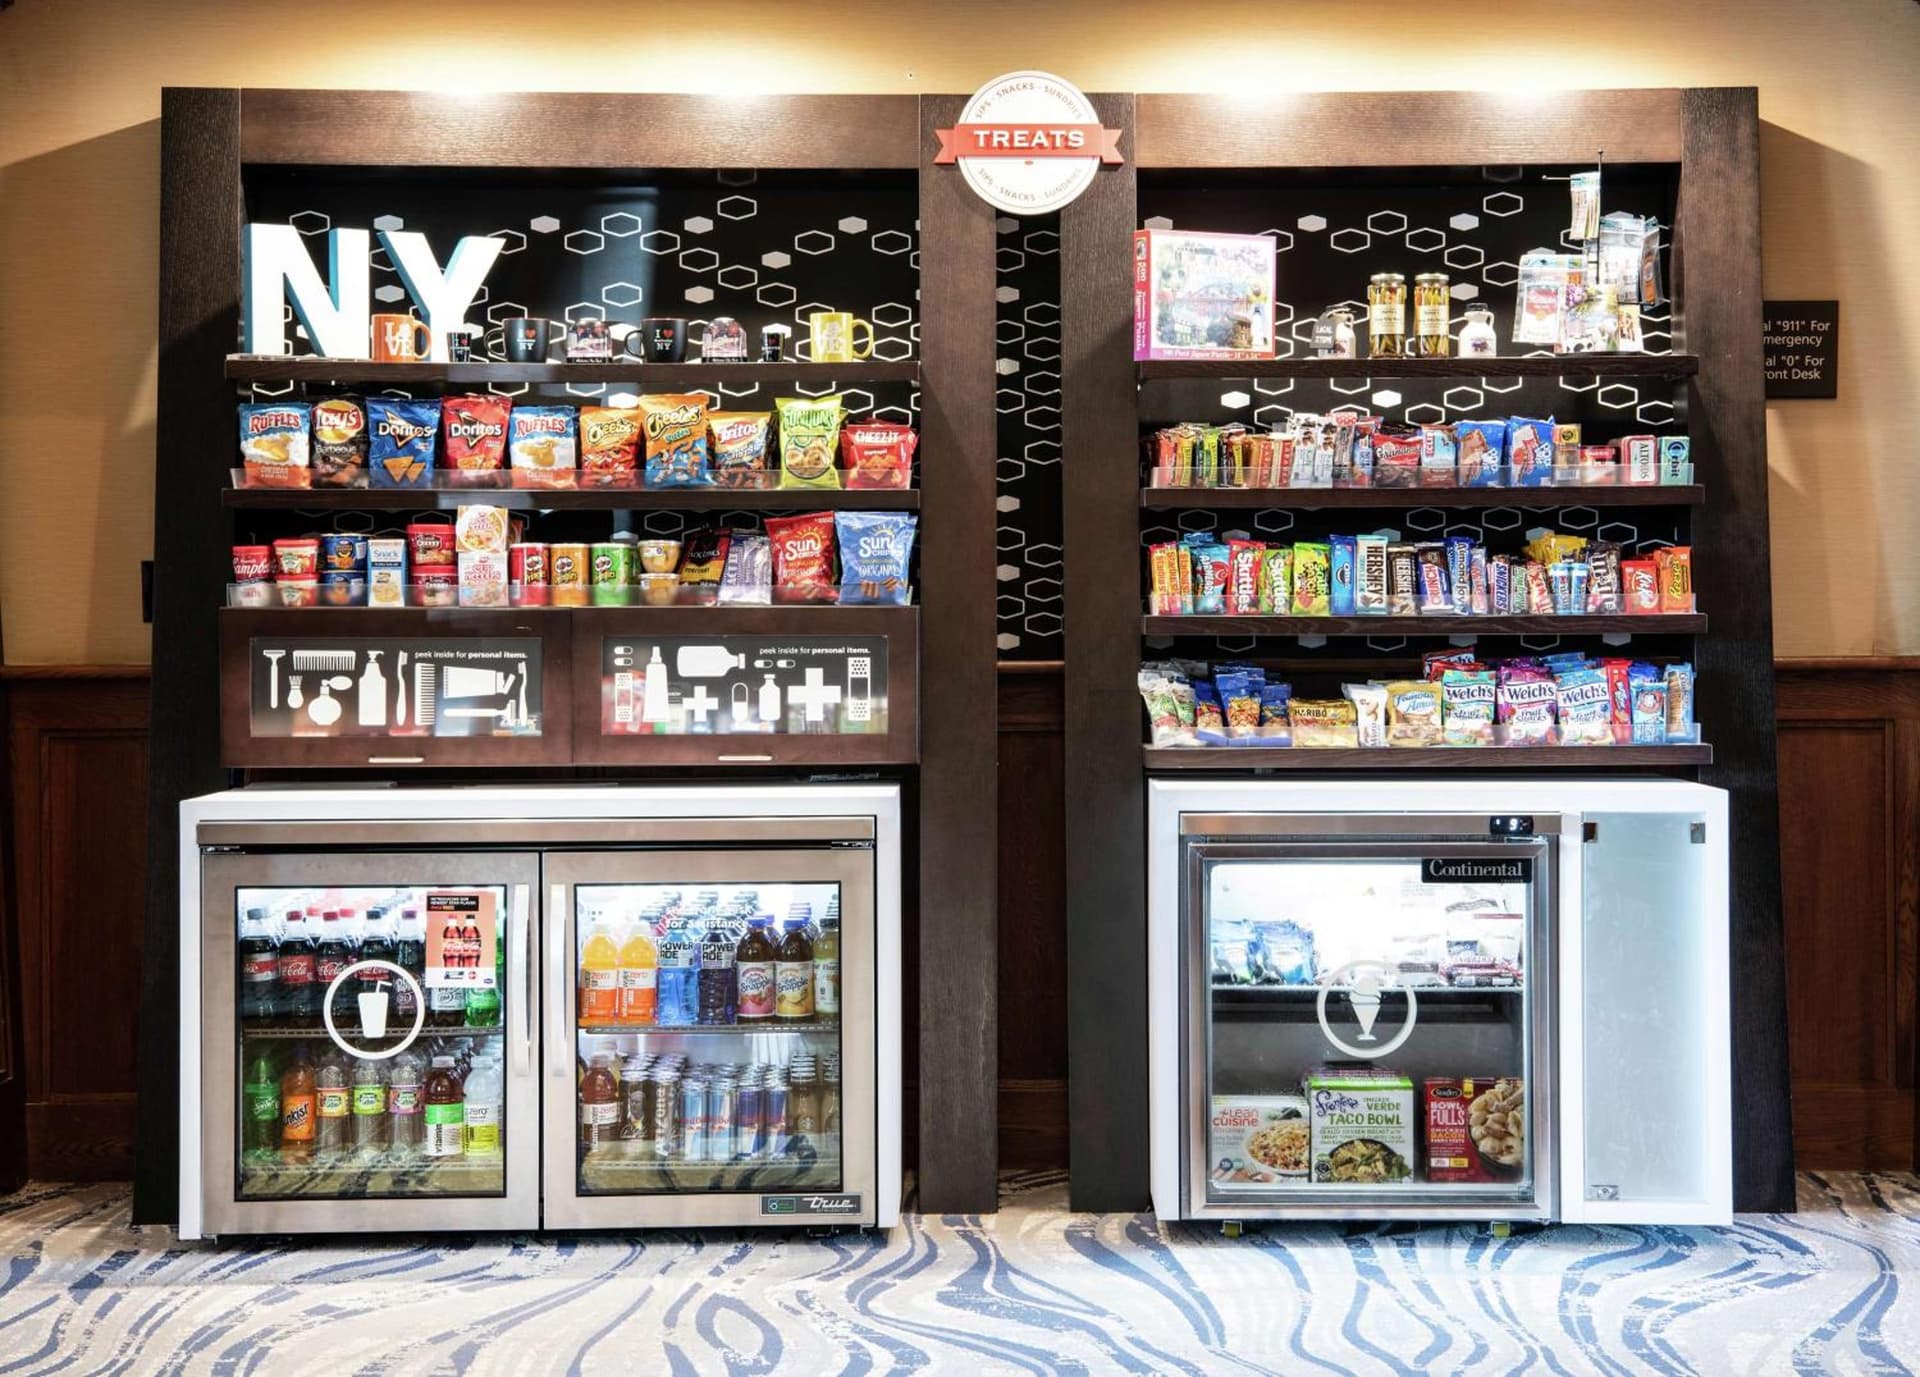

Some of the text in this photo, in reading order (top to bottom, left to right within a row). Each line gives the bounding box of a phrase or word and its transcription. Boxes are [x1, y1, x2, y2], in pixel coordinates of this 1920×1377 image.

[996, 82, 1035, 98] SNACKS
[973, 130, 1086, 148] TREATS
[999, 187, 1036, 202] SNACKS
[244, 223, 507, 362] NY
[1776, 320, 1806, 332] "911"
[1811, 321, 1831, 331] For
[1781, 355, 1799, 367] "0"
[1805, 355, 1825, 366] For
[1792, 368, 1821, 379] Desk
[249, 412, 300, 433] RUFFLES
[378, 421, 433, 437] Doritos
[451, 422, 502, 437] Doritos
[516, 417, 566, 436] RUFFLES
[647, 405, 701, 438] Cheetos
[718, 422, 758, 443] Fritos
[1640, 443, 1649, 480] ALTOIDS
[785, 539, 821, 560] Sun
[859, 535, 895, 557] Sun
[1237, 552, 1254, 613] Skittles
[1366, 546, 1384, 604] HERSHEY'S
[1456, 543, 1468, 605] Almond Joy
[1269, 558, 1288, 614] Skittles
[1424, 566, 1441, 605] CRUNCH
[1495, 563, 1507, 609] SNICKERS
[415, 651, 432, 659] peek
[434, 650, 454, 658] inside
[456, 650, 467, 658] for
[468, 651, 502, 660] personal
[759, 647, 776, 655] peek
[812, 647, 845, 656] personal
[1446, 686, 1493, 700] Welch's
[1507, 684, 1554, 700] Welch's
[1563, 685, 1608, 704] Welch's
[1294, 709, 1327, 717] HARIBO
[1429, 858, 1524, 877] Continental
[666, 919, 685, 930] for
[1212, 1117, 1258, 1126] cuisine
[1328, 1113, 1402, 1125] TACO BOWL
[1431, 1110, 1465, 1125] FULLS
[803, 1196, 856, 1208] True
